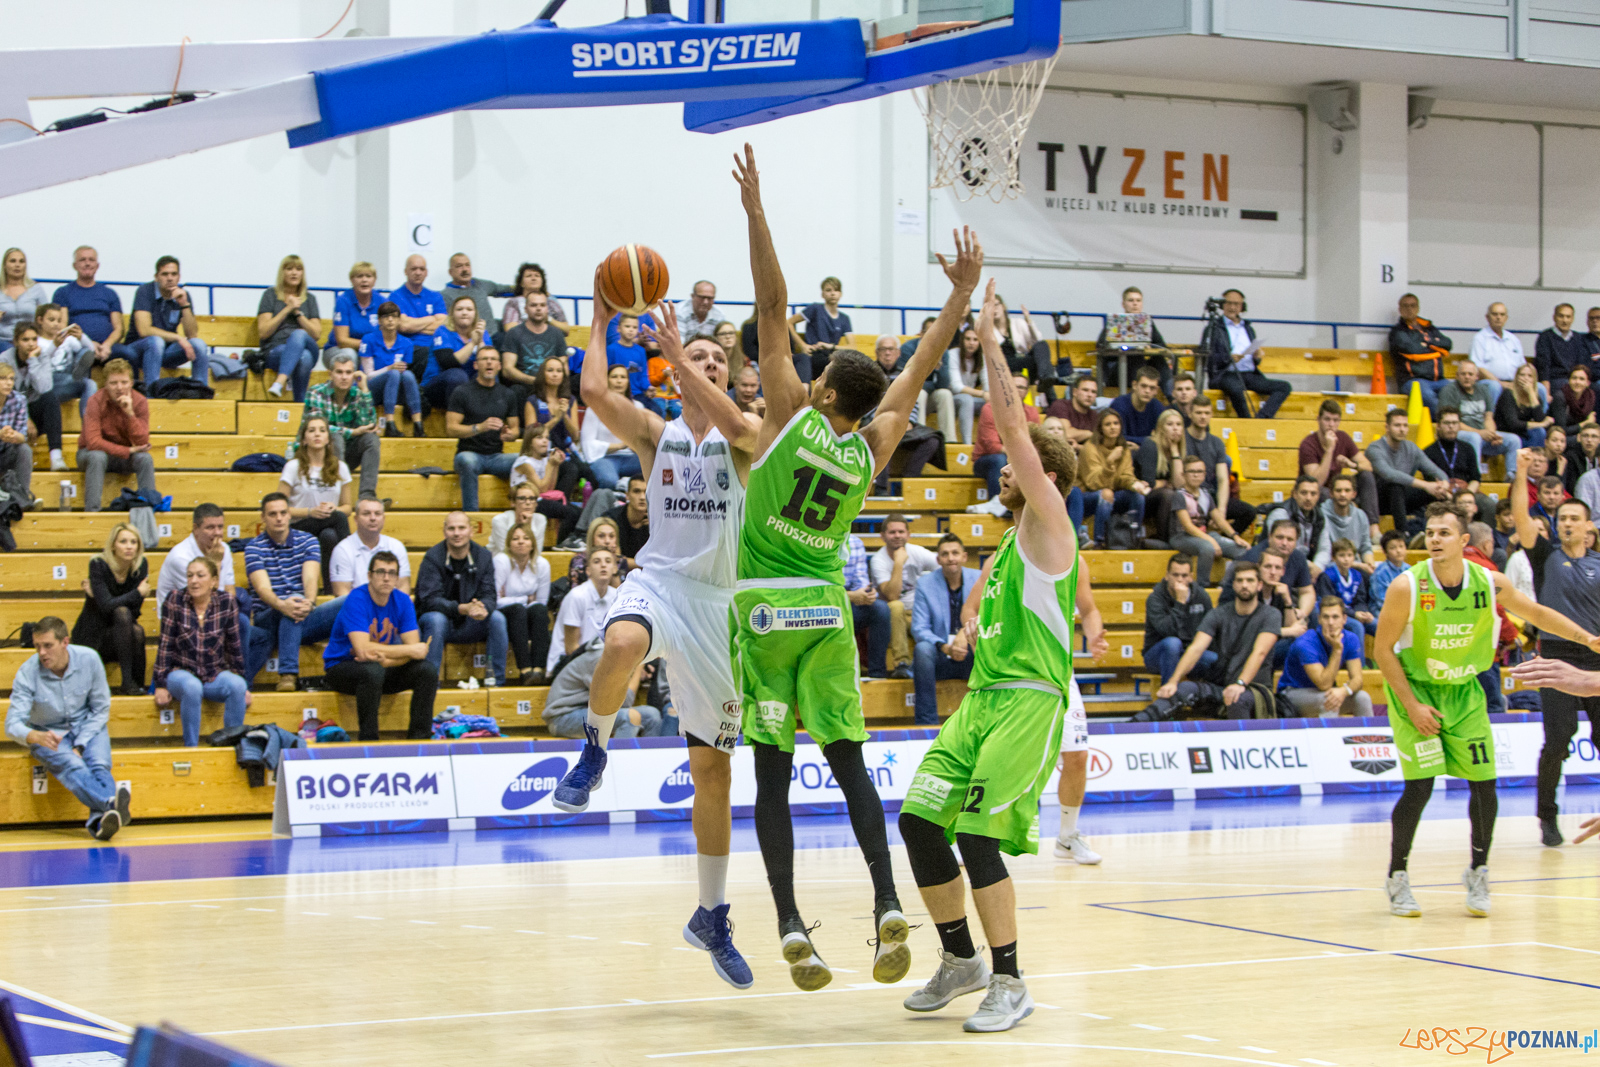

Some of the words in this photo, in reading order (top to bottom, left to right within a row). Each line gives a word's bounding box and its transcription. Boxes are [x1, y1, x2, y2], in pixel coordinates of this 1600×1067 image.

[572, 41, 676, 68] SPORT
[678, 31, 801, 72] SYSTEM
[1124, 201, 1156, 214] KLUB
[1162, 203, 1229, 218] SPORTOWY
[413, 223, 431, 247] C
[1380, 264, 1394, 283] B
[169, 447, 175, 457] 2
[683, 467, 707, 495] 14
[780, 465, 850, 531] 15
[162, 526, 168, 535] 3
[231, 526, 237, 536] 2
[57, 567, 63, 577] 5
[1473, 590, 1487, 609] 11
[785, 617, 838, 628] INVESTMENT
[1435, 623, 1474, 636] ZNICZ
[269, 659, 275, 670] 3
[519, 702, 530, 712] 16
[164, 711, 171, 721] 5
[1220, 747, 1308, 771] NICKEL
[1352, 746, 1392, 759] JOKER
[1468, 742, 1490, 765] 11
[1126, 752, 1180, 771] DELIK
[37, 780, 44, 791] 7
[297, 772, 439, 799] BIOFARM
[509, 774, 558, 792] atrem
[309, 803, 341, 811] POLSKI
[345, 801, 396, 810] PRODUCENT
